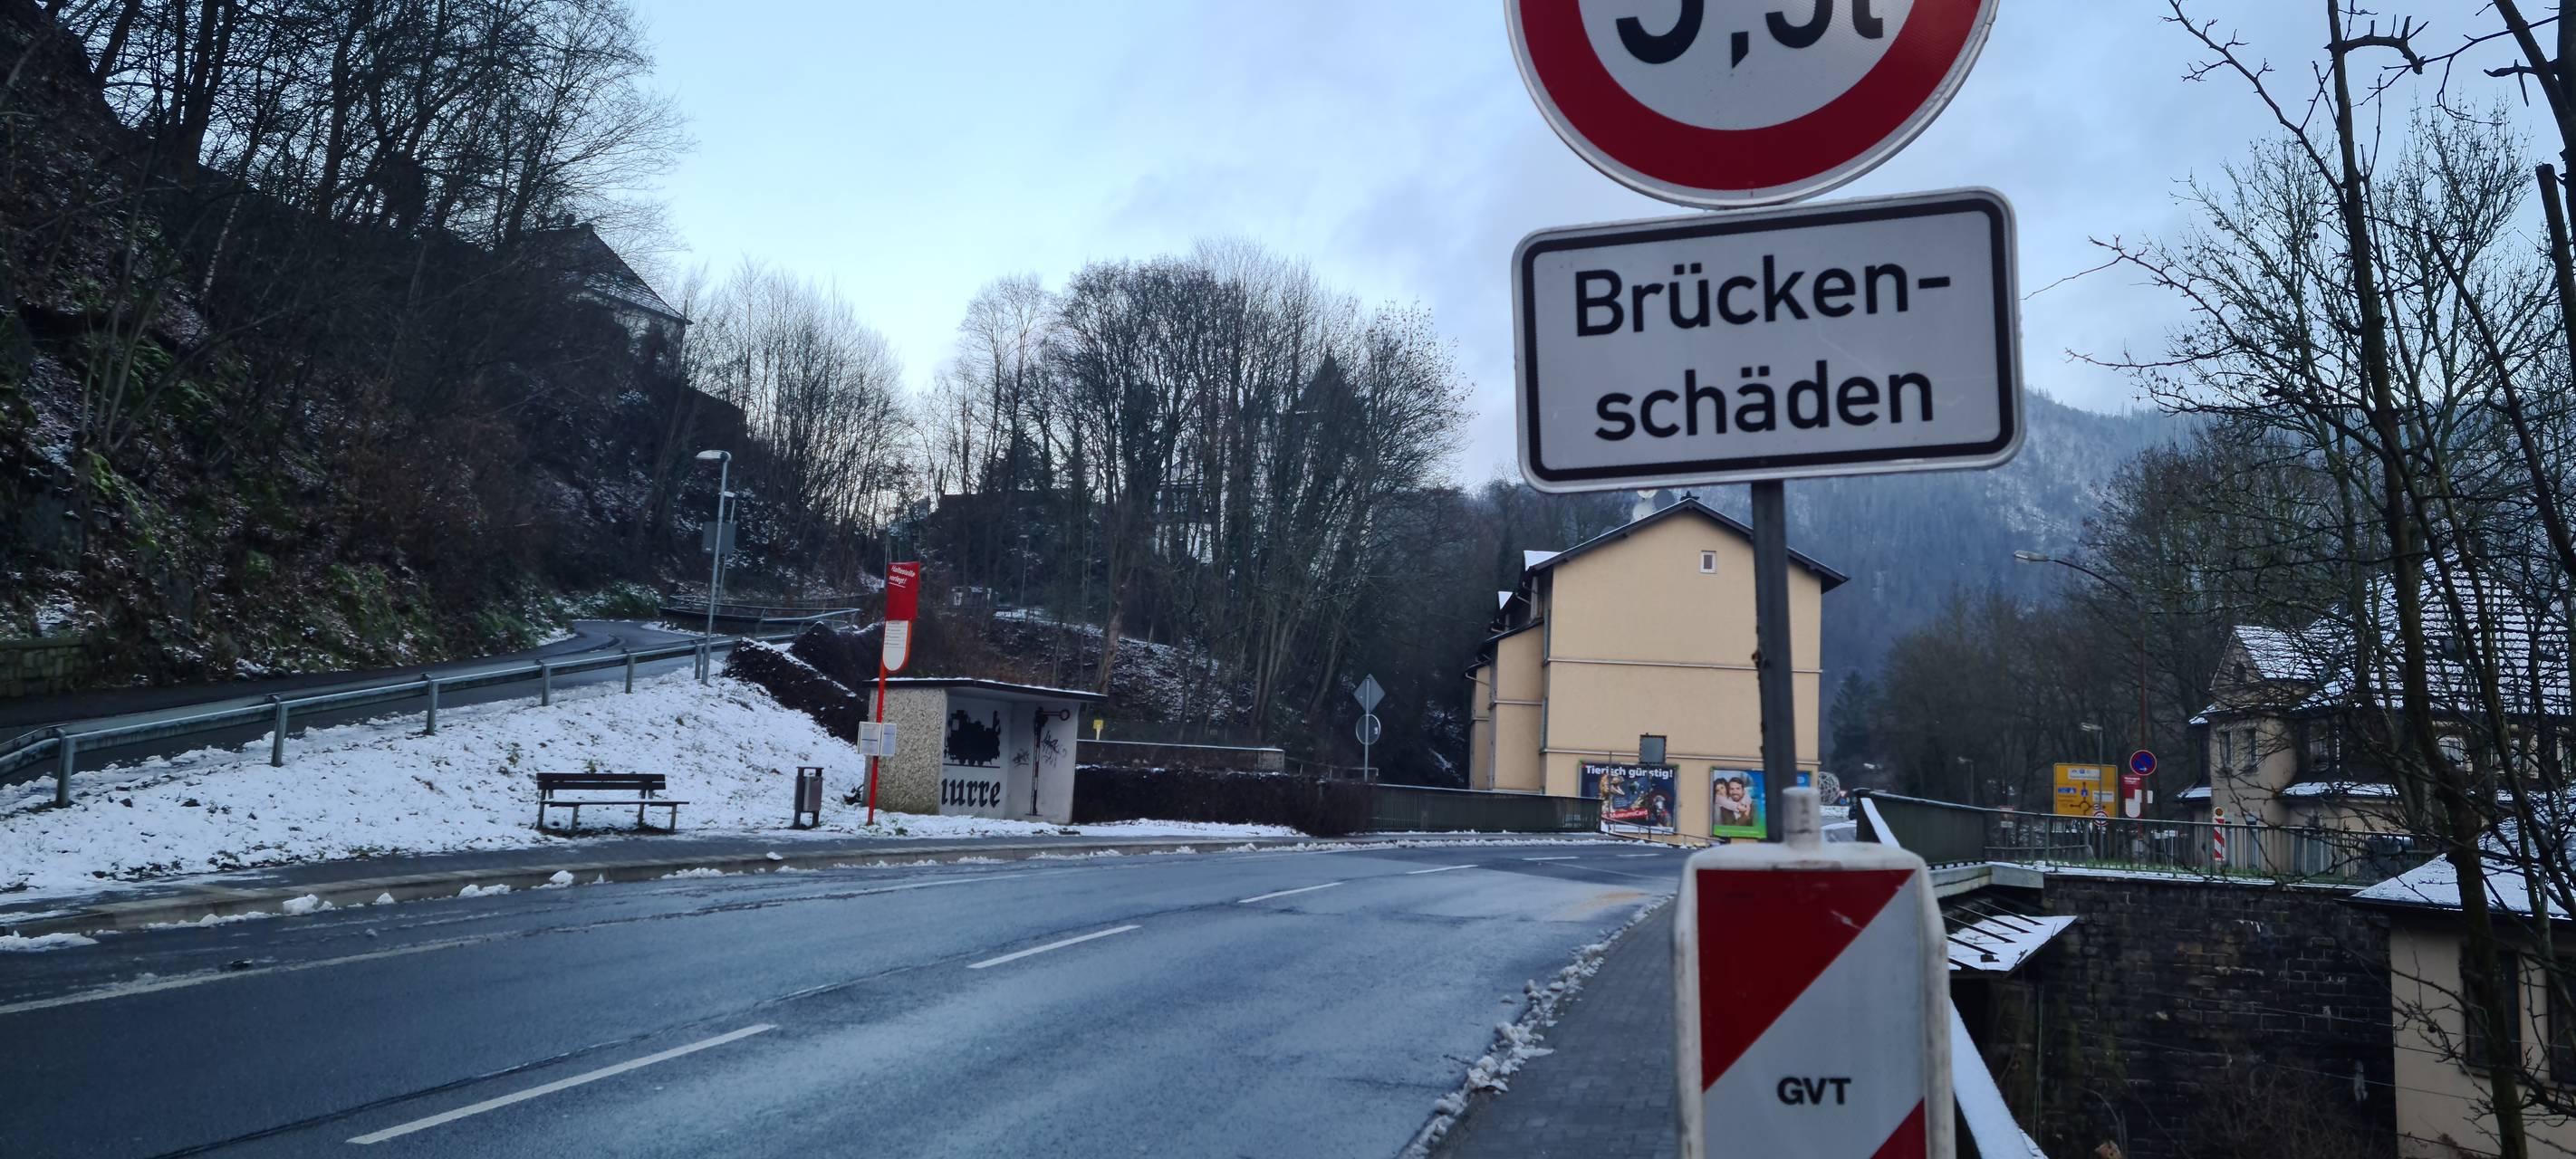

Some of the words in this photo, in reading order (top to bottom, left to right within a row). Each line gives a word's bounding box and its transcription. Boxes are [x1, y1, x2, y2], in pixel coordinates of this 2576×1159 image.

[1575, 254, 1951, 338] Brücken-
[1594, 359, 1933, 441] schäden
[1776, 1076, 1851, 1106] GVT
